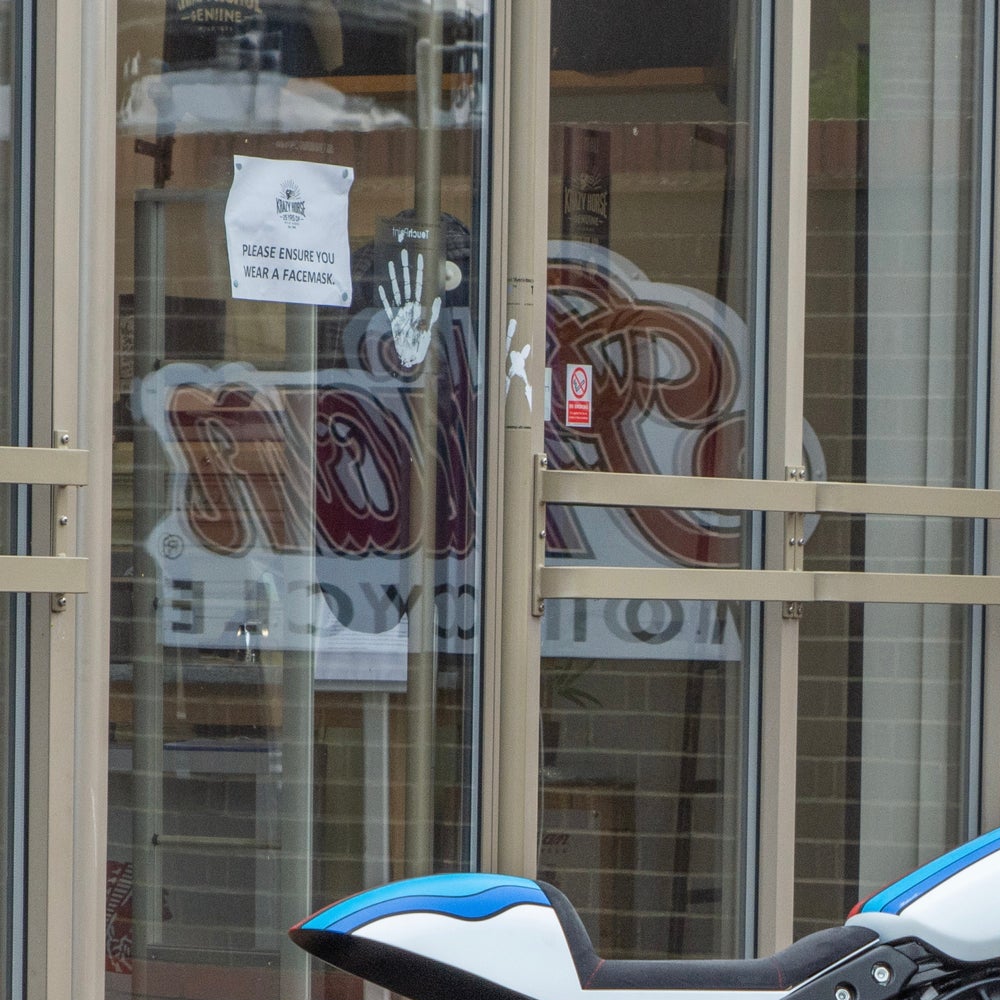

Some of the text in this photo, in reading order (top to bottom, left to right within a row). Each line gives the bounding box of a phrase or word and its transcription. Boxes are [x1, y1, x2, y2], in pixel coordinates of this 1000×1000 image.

[276, 197, 306, 218] KRAZY HORSE
[242, 244, 335, 264] PLEASE ENSURE YOU
[243, 265, 335, 285] WEAR A FACEMASK.
